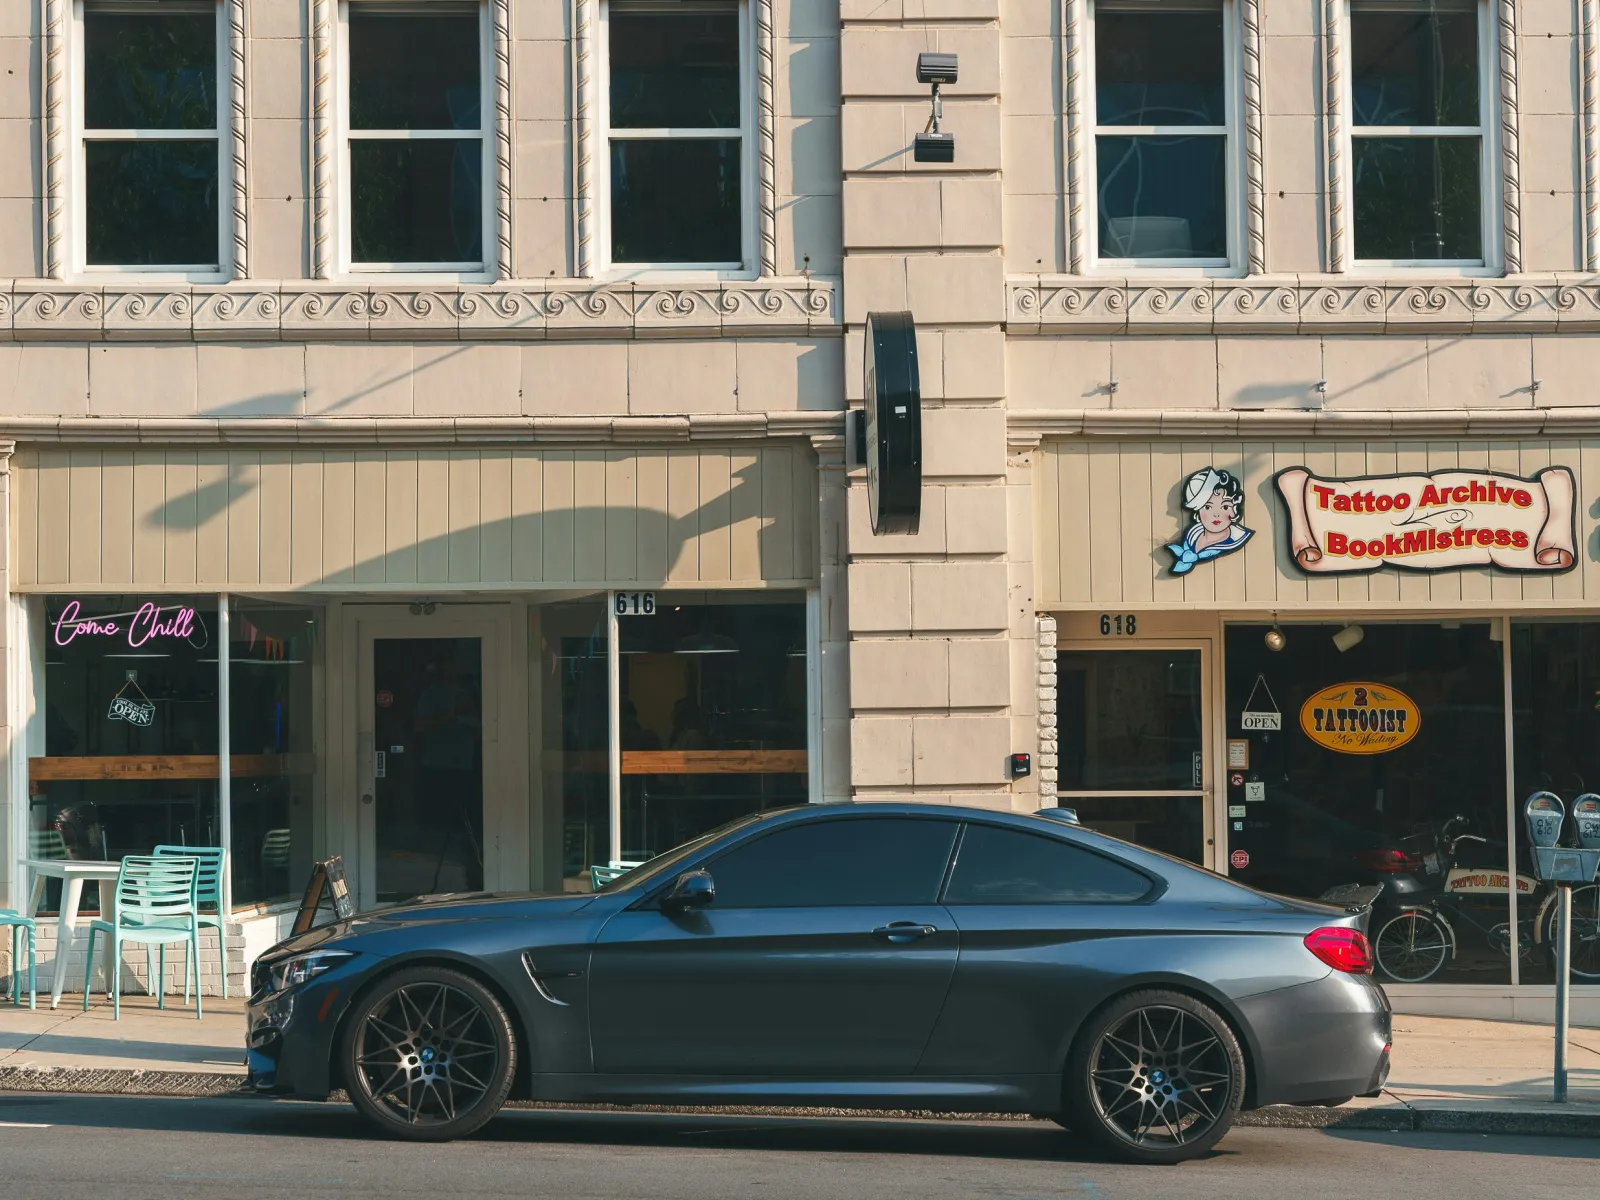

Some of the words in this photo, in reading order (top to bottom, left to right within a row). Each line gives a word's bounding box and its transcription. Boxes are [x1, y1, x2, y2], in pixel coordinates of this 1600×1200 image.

[1312, 484, 1411, 514] Tattoo
[1417, 480, 1533, 508] Archive
[616, 592, 654, 614] 616
[55, 600, 120, 646] Come
[128, 602, 195, 647] Chill
[1100, 614, 1136, 635] 618
[1353, 687, 1368, 706] 2
[114, 703, 149, 724] OPEN
[1244, 717, 1279, 729] OPEN
[1313, 708, 1407, 732] TATTOOIST
[1332, 733, 1355, 745] No
[1356, 732, 1398, 747] Waiting
[1451, 874, 1487, 889] TATTOO
